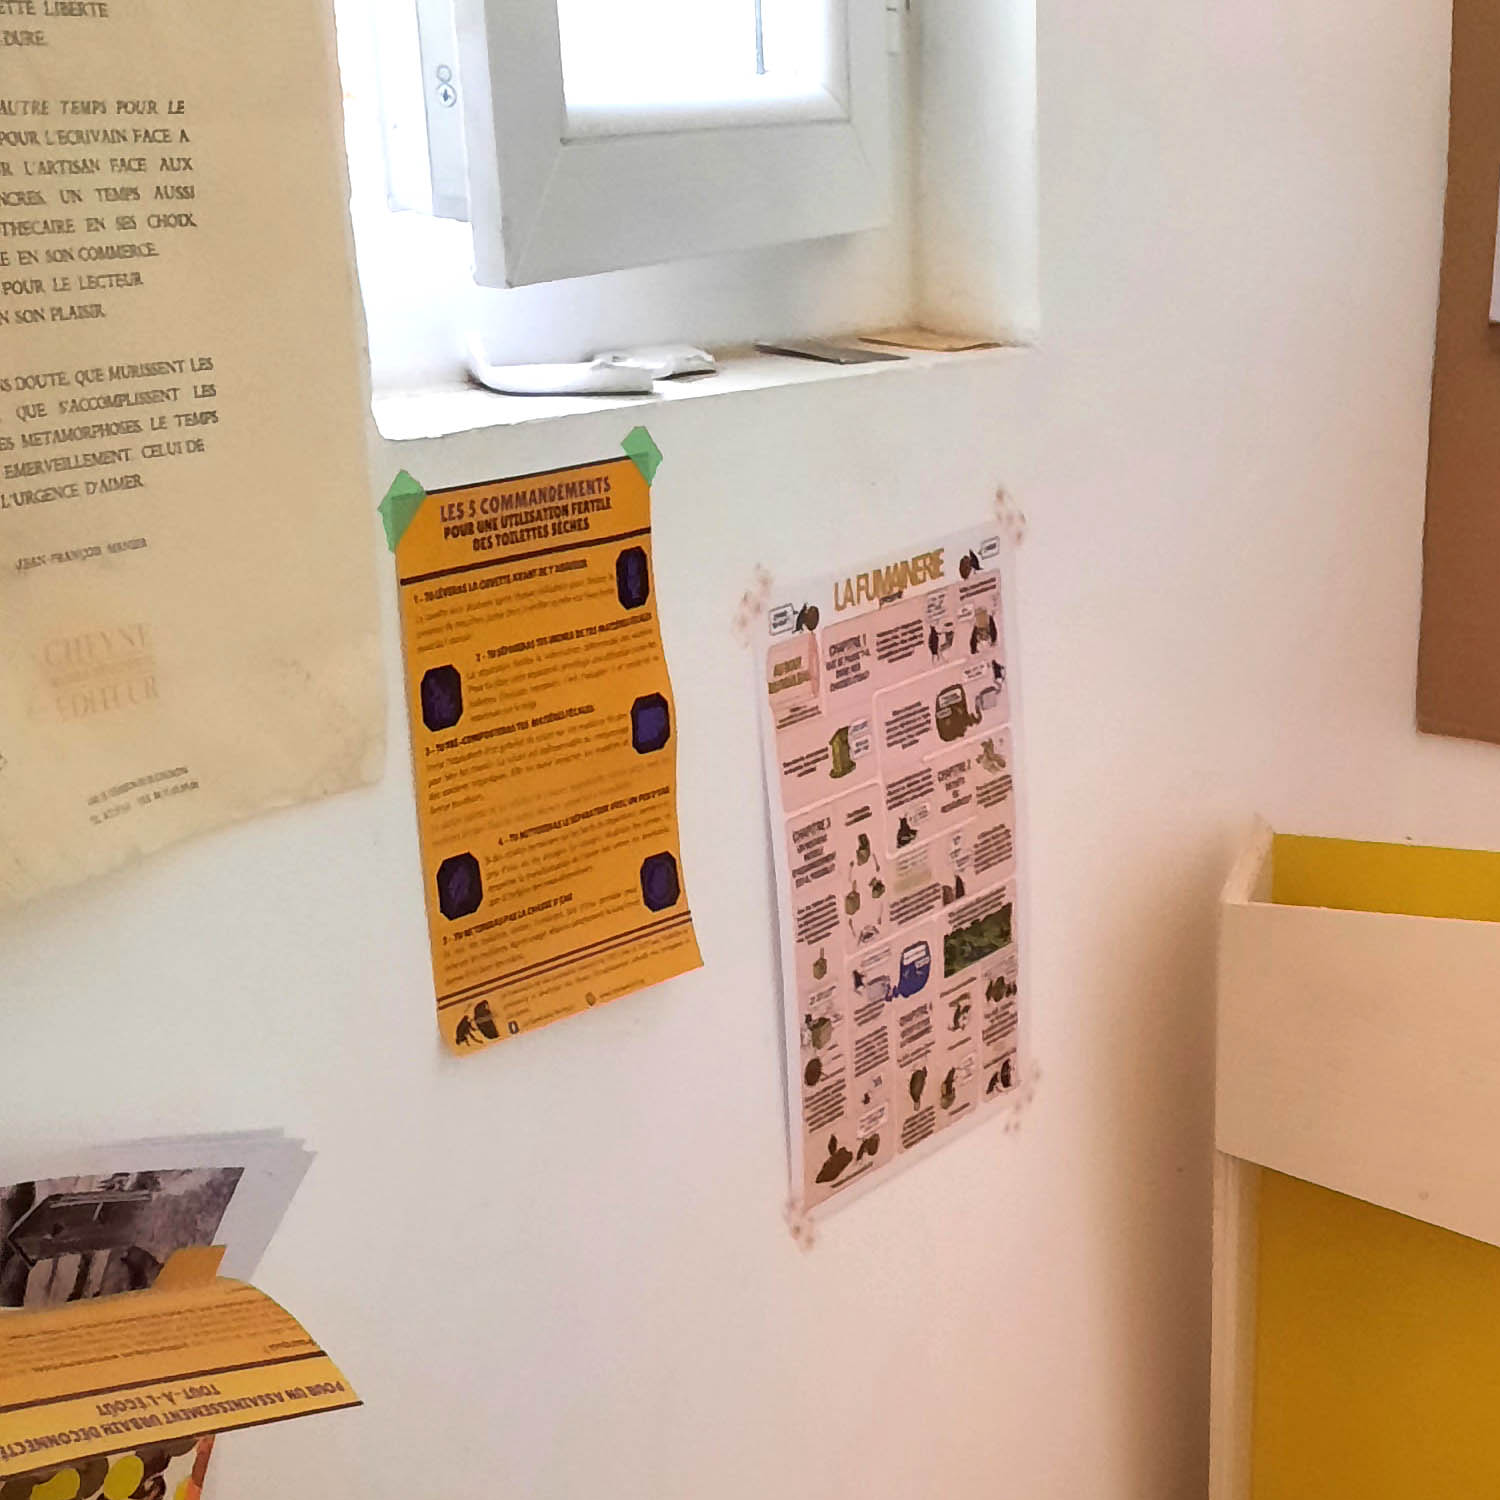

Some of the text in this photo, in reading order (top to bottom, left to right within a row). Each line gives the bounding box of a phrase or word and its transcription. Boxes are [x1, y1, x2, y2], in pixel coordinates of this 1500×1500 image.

[61, 100, 107, 115] TEMPS
[116, 100, 158, 115] POUR
[167, 100, 185, 115] LE
[132, 129, 172, 144] FACE
[179, 128, 190, 143] A
[110, 157, 147, 173] FACE
[160, 157, 194, 172] AUX
[59, 189, 83, 204] UN
[95, 186, 141, 202] TEMPS
[154, 185, 196, 200] AUSSI
[86, 217, 106, 232] EN
[18, 249, 39, 266] EN
[46, 247, 75, 264] SON
[3, 279, 46, 296] POUR
[53, 277, 72, 292] LE
[15, 306, 46, 324] SON
[15, 371, 70, 391] DOUTE
[75, 367, 105, 387] QUE
[190, 356, 214, 372] LES
[16, 402, 48, 422] QUE
[193, 383, 217, 399] LES
[150, 415, 168, 431] LE
[174, 410, 219, 428] TEMPS
[185, 438, 205, 453] DE
[440, 501, 464, 522] LES
[480, 476, 611, 515] COMMANDEMENTS
[444, 520, 475, 540] POUR
[476, 514, 500, 534] UNE
[472, 535, 494, 551] DES
